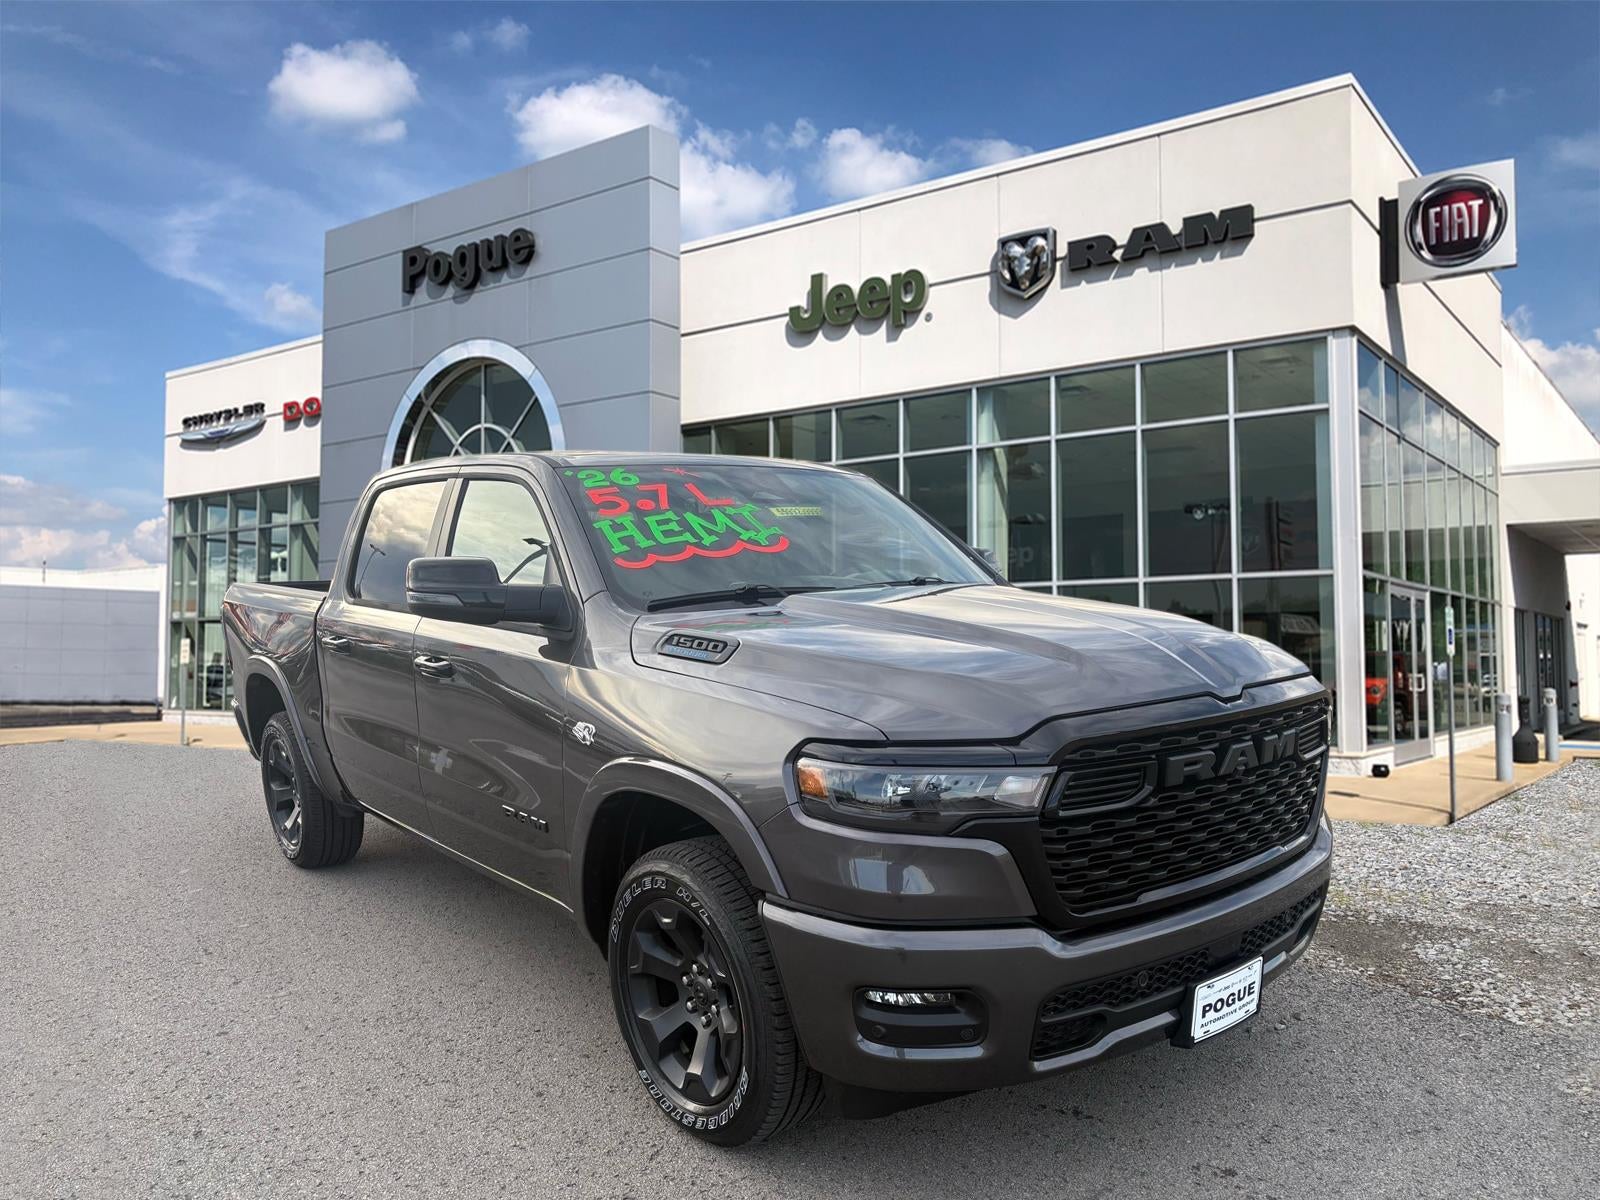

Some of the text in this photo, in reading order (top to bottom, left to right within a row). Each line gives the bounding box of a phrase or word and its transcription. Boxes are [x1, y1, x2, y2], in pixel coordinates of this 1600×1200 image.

[1067, 203, 1255, 272] RAM
[1428, 198, 1484, 246] FIAT
[402, 227, 536, 294] Pogue
[788, 268, 929, 332] Jeep
[585, 482, 736, 517] 5.7 L
[593, 503, 785, 554] HEMI
[671, 635, 724, 652] 1500
[1165, 727, 1298, 788] RAM
[610, 876, 667, 943] DUELER
[1200, 1007, 1238, 1029] AUTOMOTIVE
[1201, 980, 1256, 1019] POGUE
[639, 1065, 749, 1130] BRIDGESTONE
